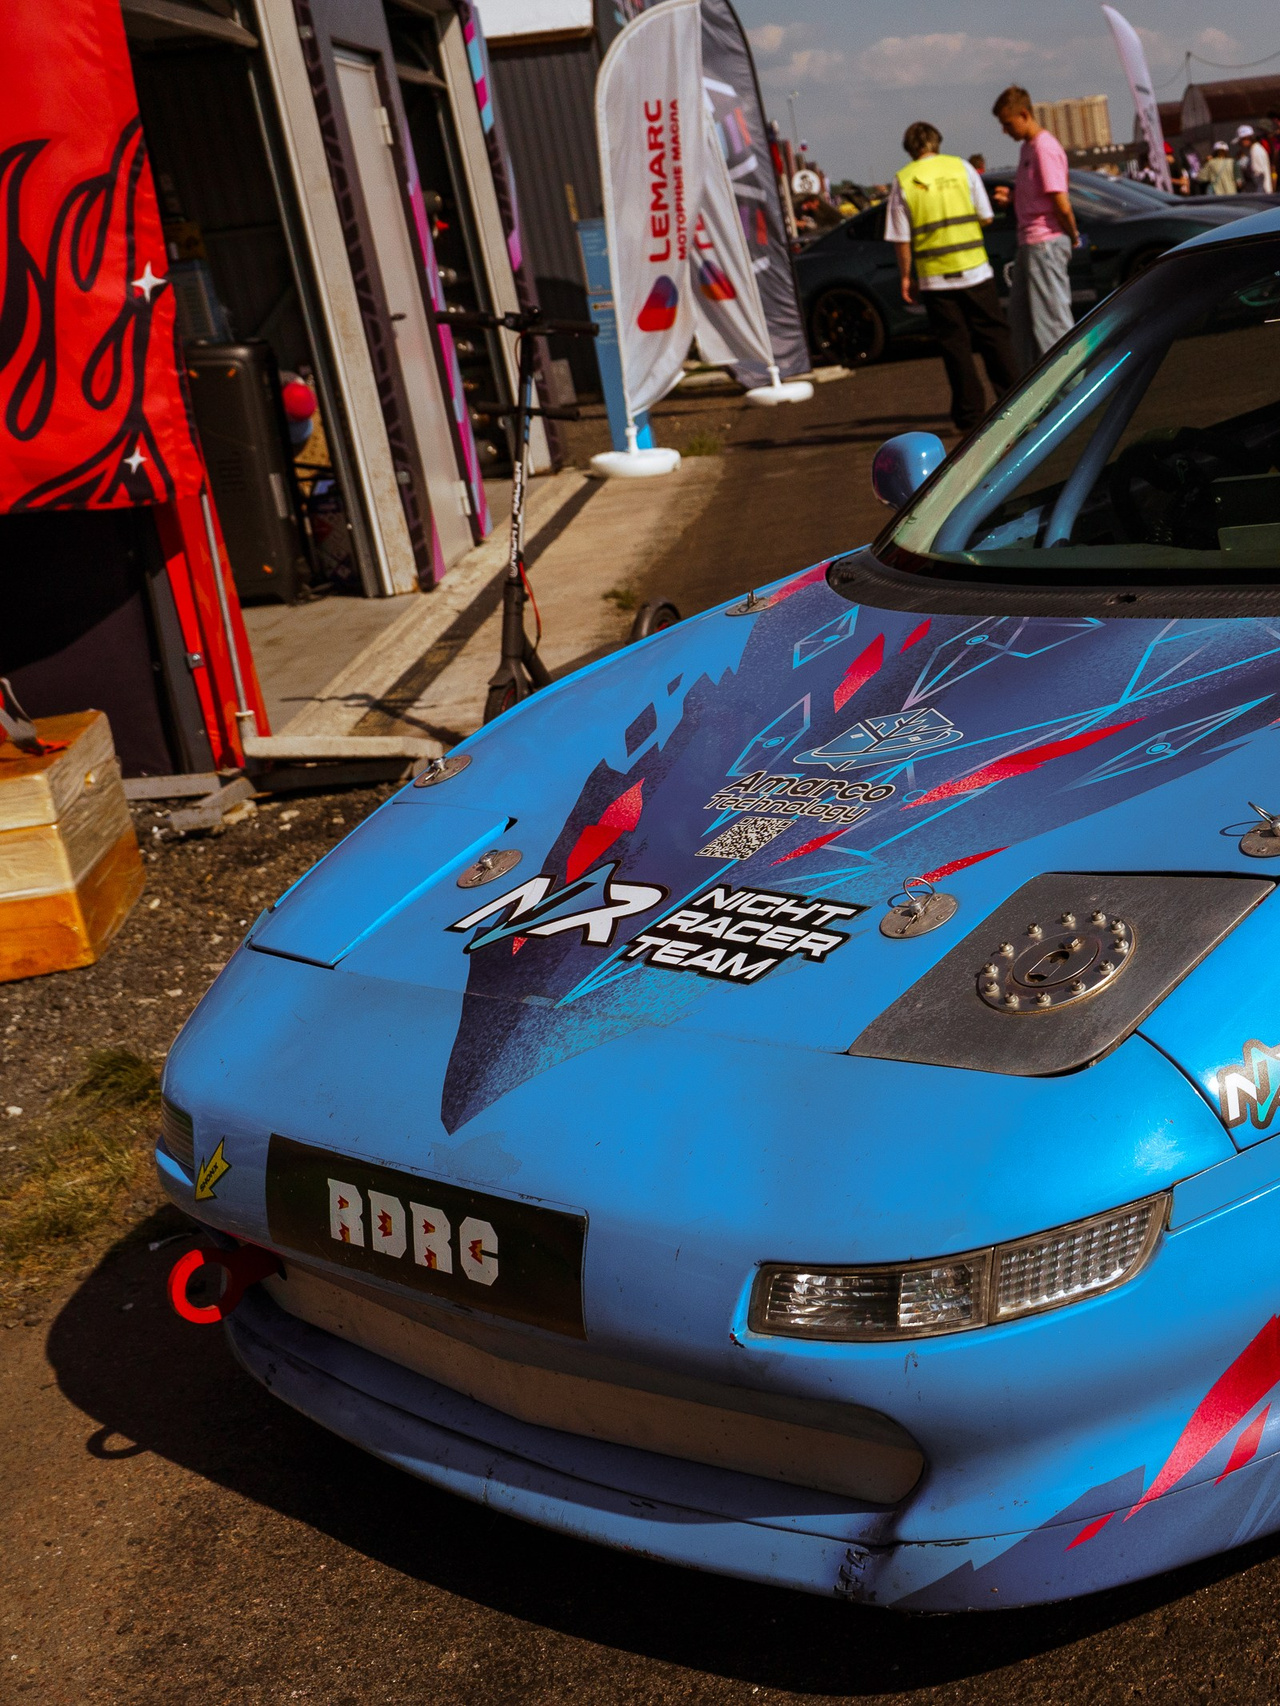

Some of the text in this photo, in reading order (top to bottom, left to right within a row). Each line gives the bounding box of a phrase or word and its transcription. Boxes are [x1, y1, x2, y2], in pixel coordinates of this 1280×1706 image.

[644, 99, 671, 262] LEMARC
[669, 99, 688, 261] МОТОРНЫЕ МАСЛА
[703, 793, 871, 824] Technology
[720, 770, 896, 803] Amarco
[692, 888, 857, 926] NIGHT
[656, 910, 844, 958] RACER
[626, 935, 779, 980] TEAM
